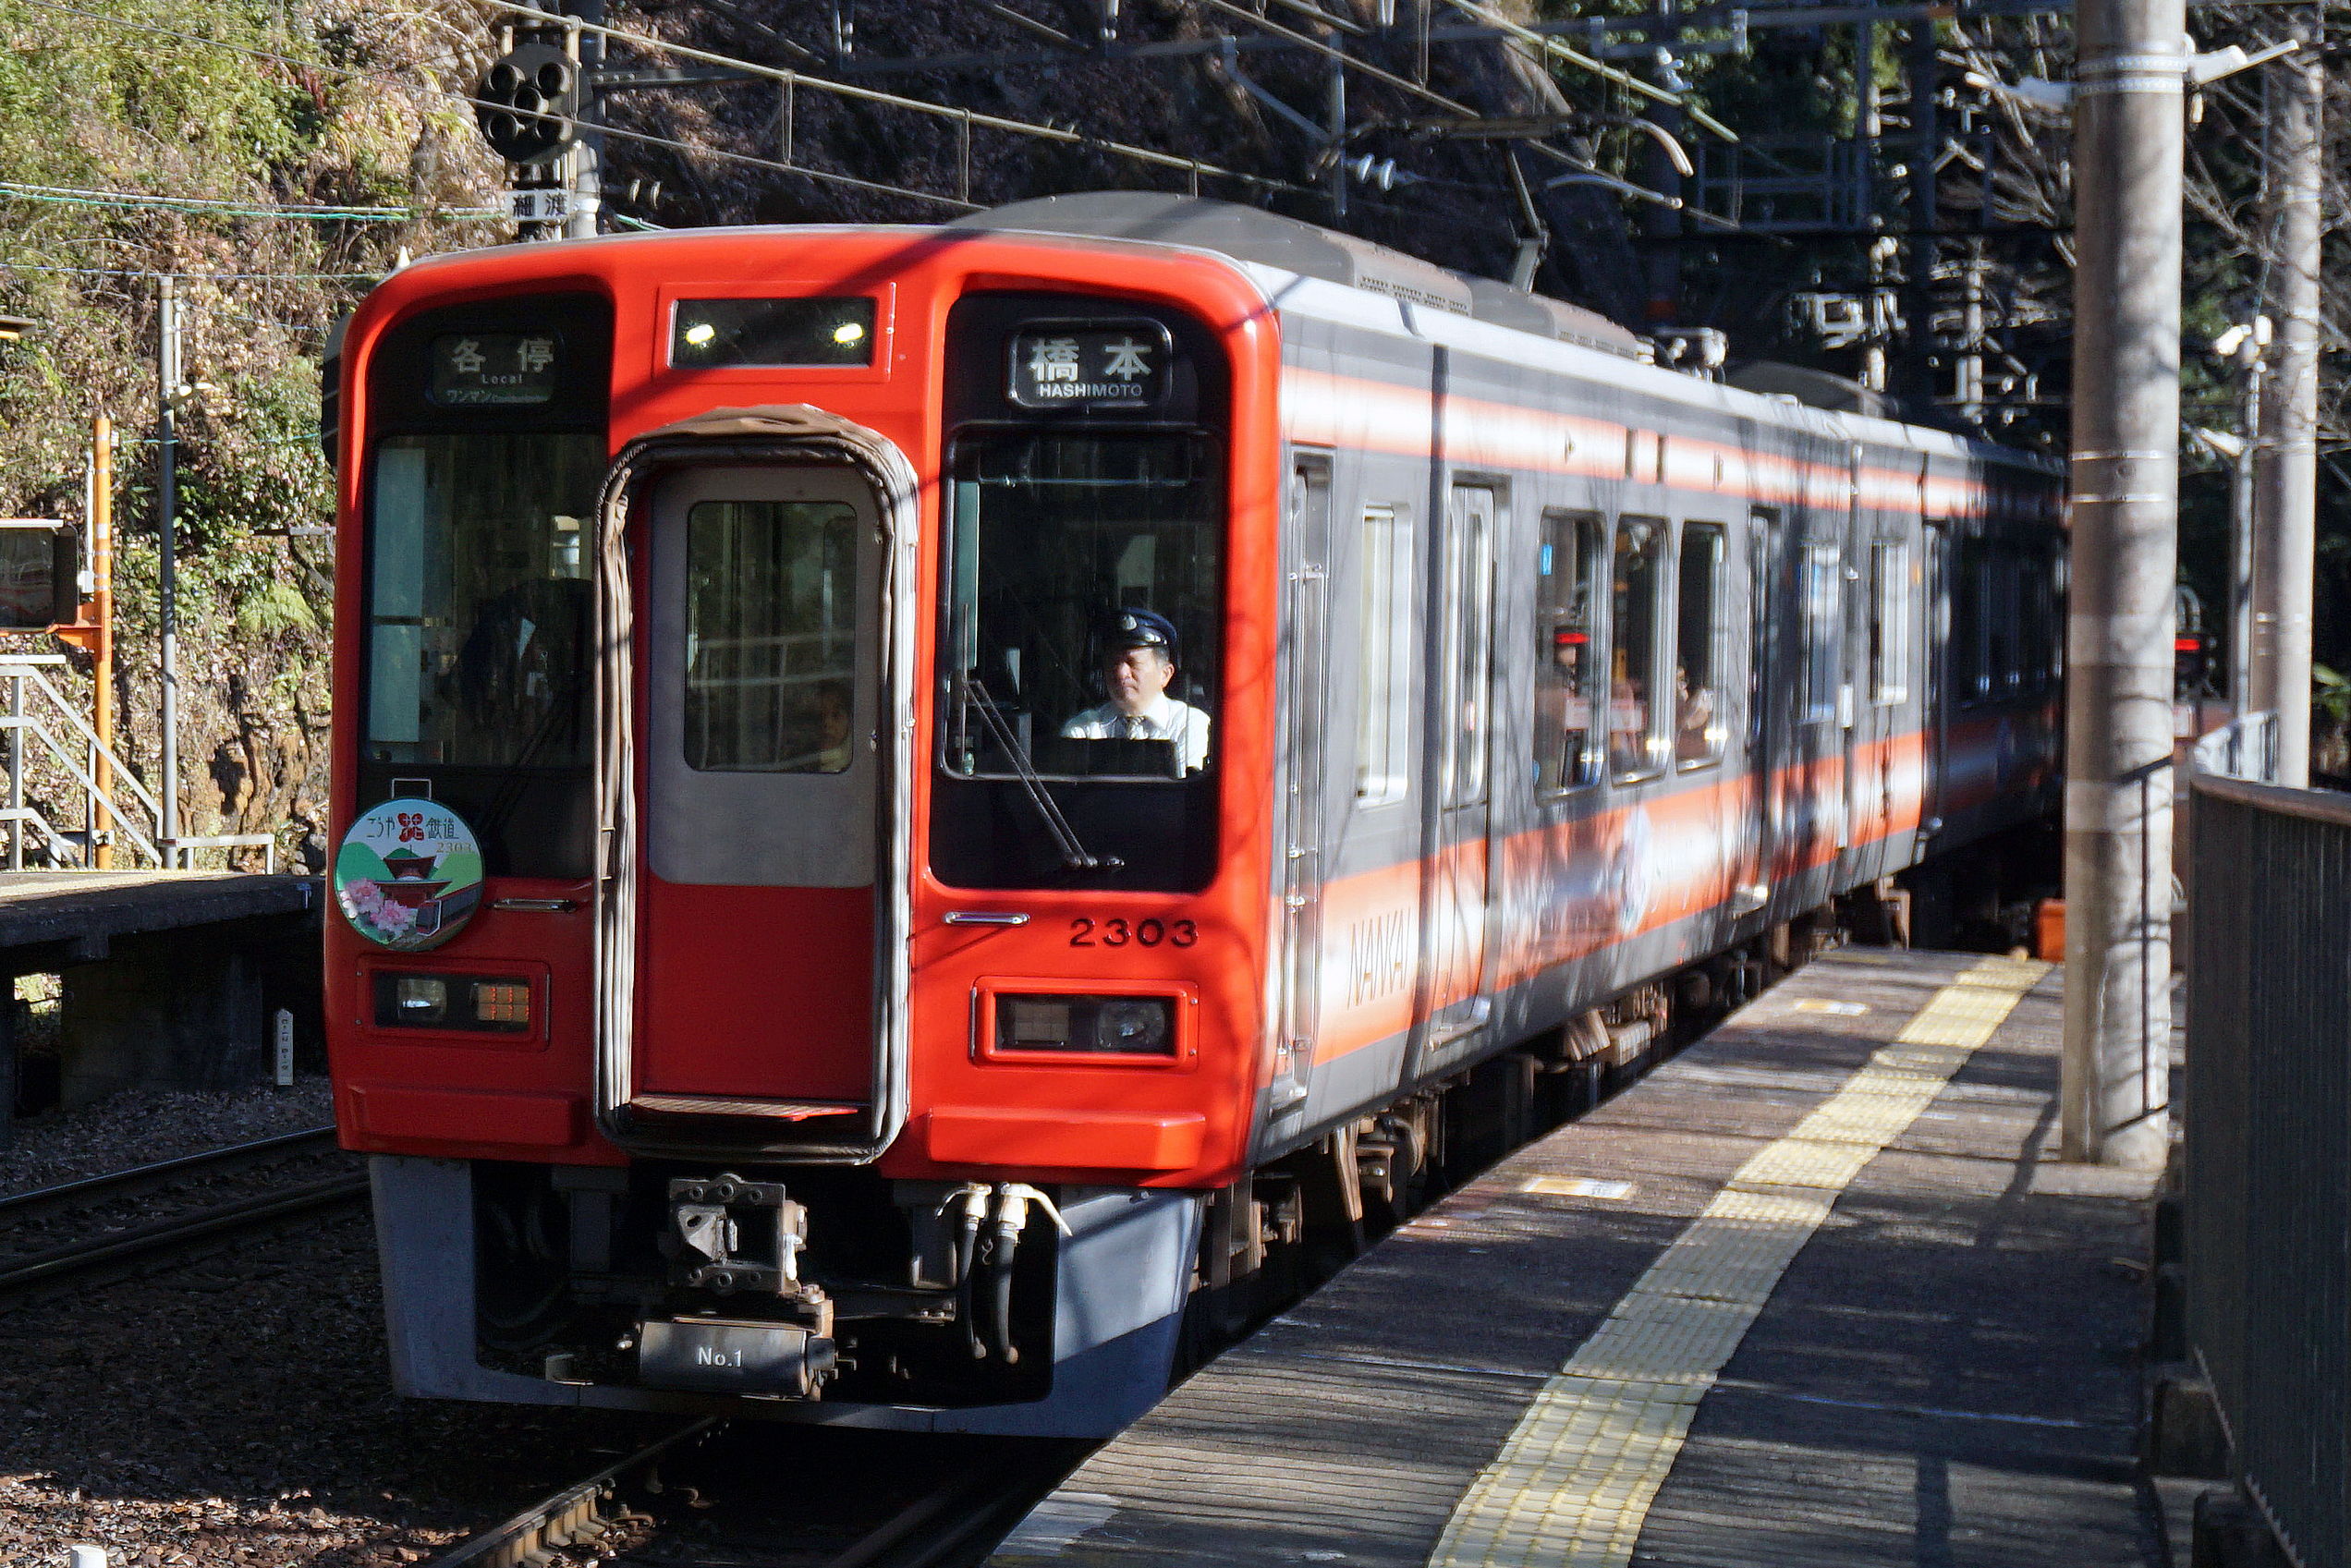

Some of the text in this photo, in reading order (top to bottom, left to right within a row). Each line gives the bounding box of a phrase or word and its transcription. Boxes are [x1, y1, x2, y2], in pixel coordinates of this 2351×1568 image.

[451, 337, 554, 372] 各停
[1028, 336, 1152, 382] 橋本
[481, 373, 523, 385] Local
[1039, 383, 1143, 397] HASHIMOTO
[436, 842, 474, 854] 2303
[1069, 918, 1200, 948] 2303
[1346, 906, 1411, 1011] NANKAI
[698, 1346, 743, 1368] No.1
